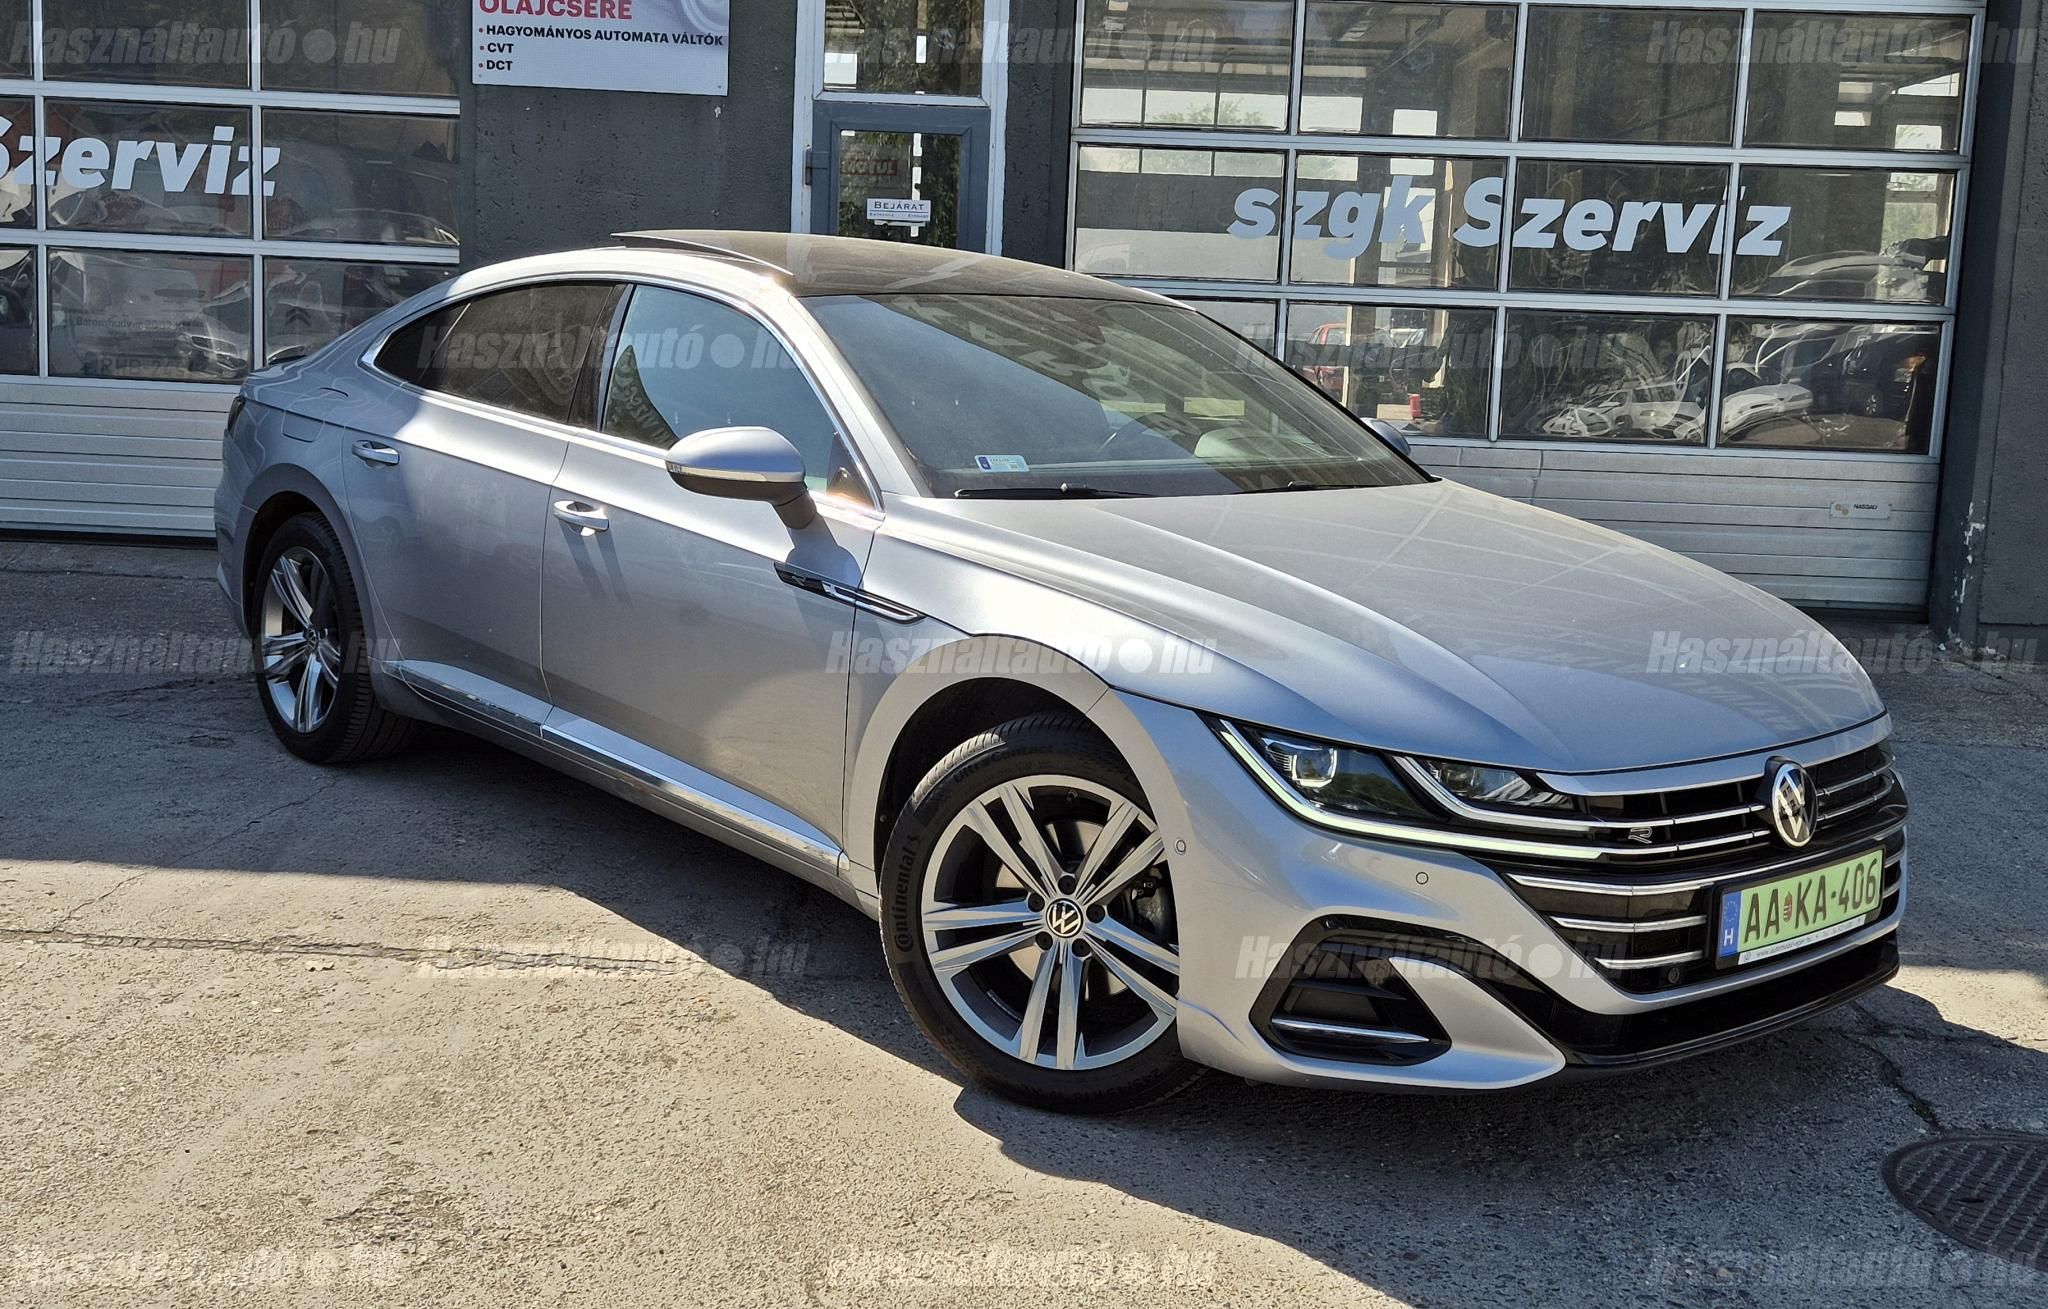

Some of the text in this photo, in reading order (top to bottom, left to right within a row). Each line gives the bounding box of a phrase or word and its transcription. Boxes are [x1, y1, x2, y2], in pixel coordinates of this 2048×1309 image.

[486, 25, 723, 46] HAGYOMÁNYOS AUTOMATA VÁLTÓK
[487, 42, 514, 53] CVT
[486, 60, 513, 71] DCT
[874, 201, 925, 210] BEJÁRAT
[1226, 176, 1792, 260] szgk Szerviz
